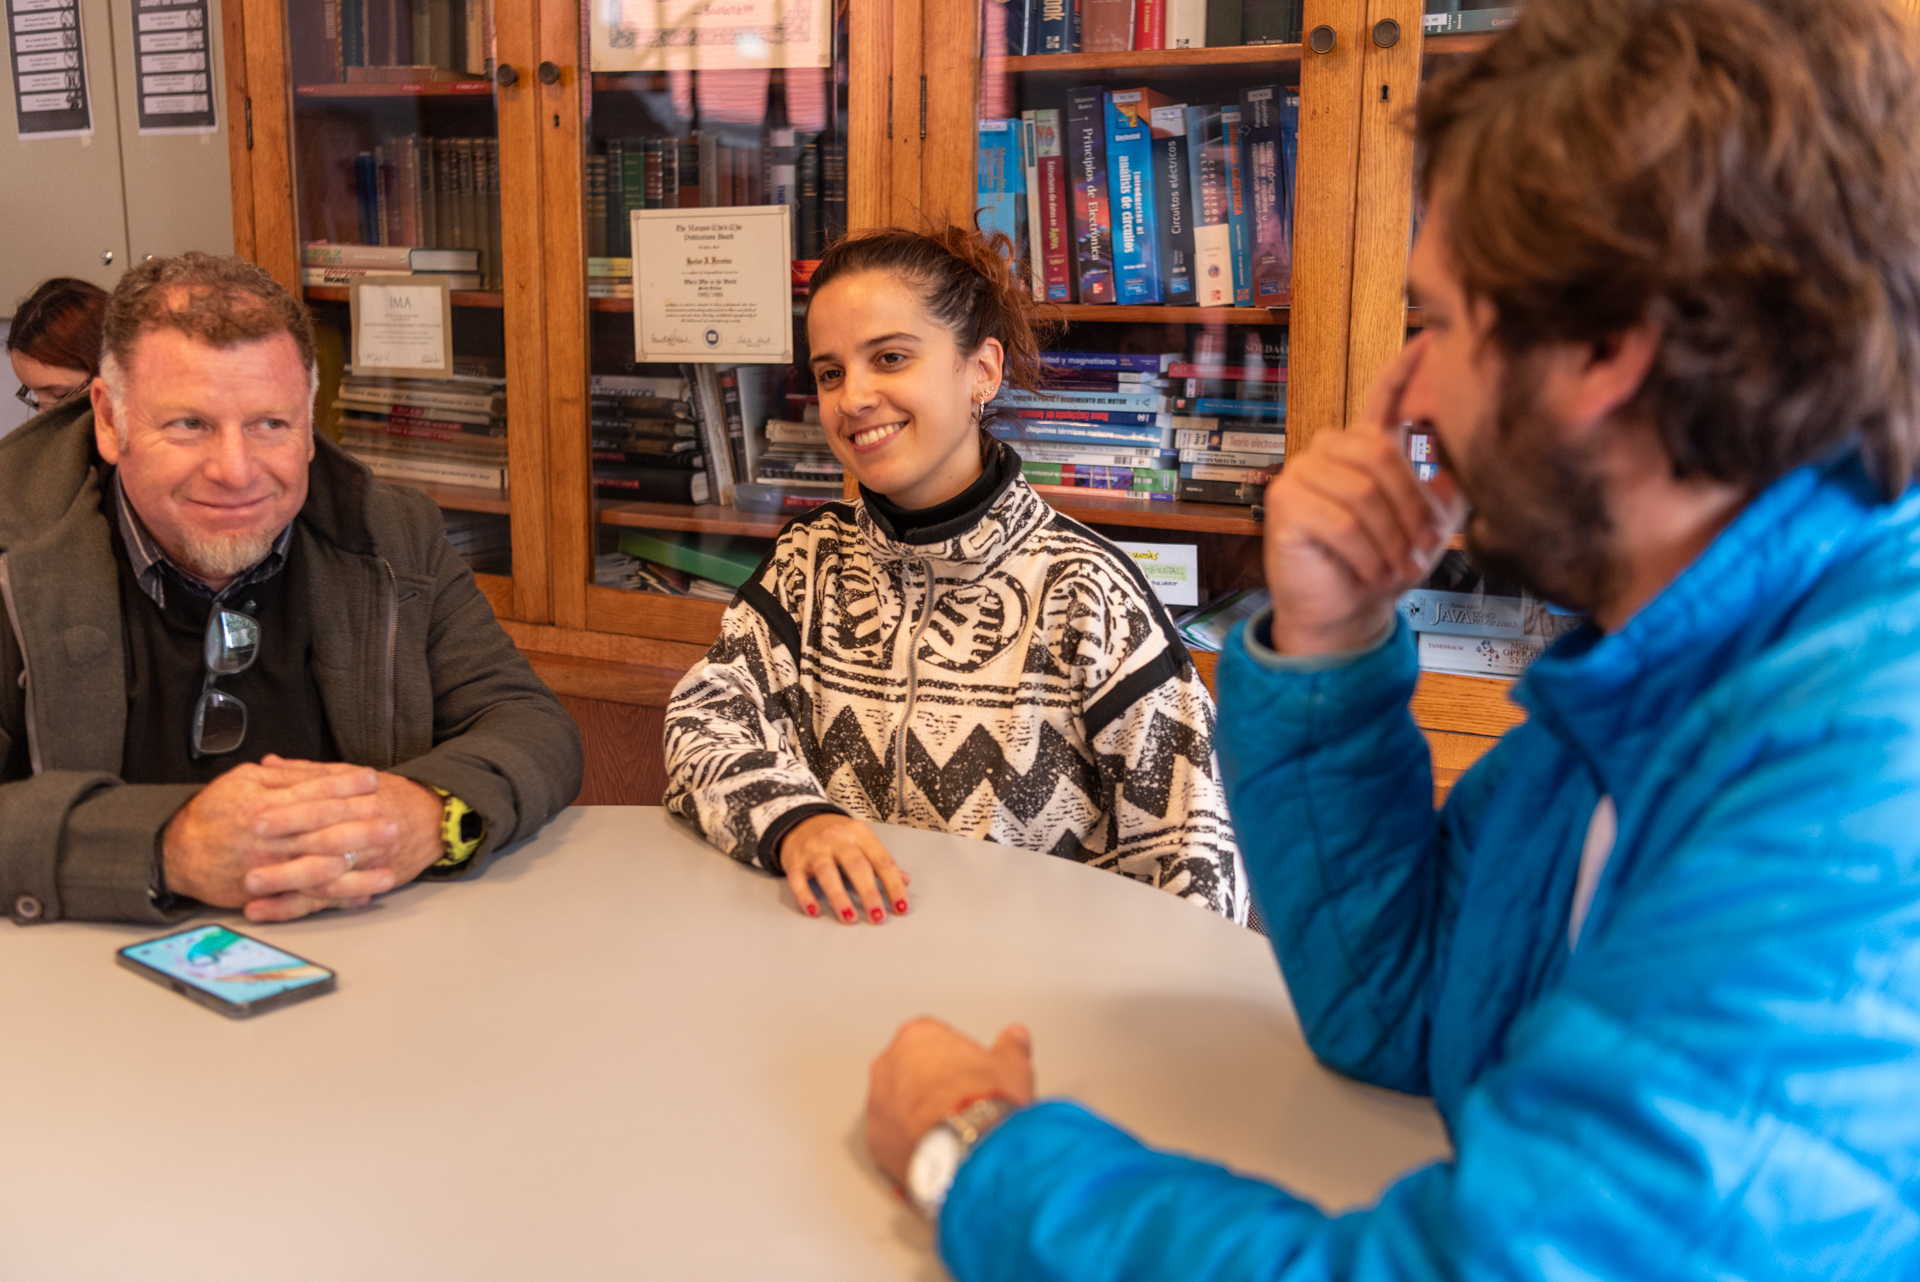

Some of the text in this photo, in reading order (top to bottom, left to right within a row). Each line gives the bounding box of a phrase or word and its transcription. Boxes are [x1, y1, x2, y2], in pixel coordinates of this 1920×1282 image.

[1260, 100, 1269, 127] oylestad
[1047, 161, 1056, 193] Estructuras
[1167, 140, 1182, 234] Circuitos eléctricos
[1208, 160, 1218, 222] CIRCUITOS
[1082, 128, 1101, 261] Principios de Electrónica
[1119, 155, 1135, 253] análisis de circuitos
[1133, 171, 1145, 235] Introducción al
[1049, 202, 1058, 218] datos
[1068, 358, 1117, 366] magnetismo
[1429, 603, 1473, 626] JAVA
[1472, 619, 1519, 629] PROGRAMAR
[1428, 643, 1464, 651] TANENBAUM
